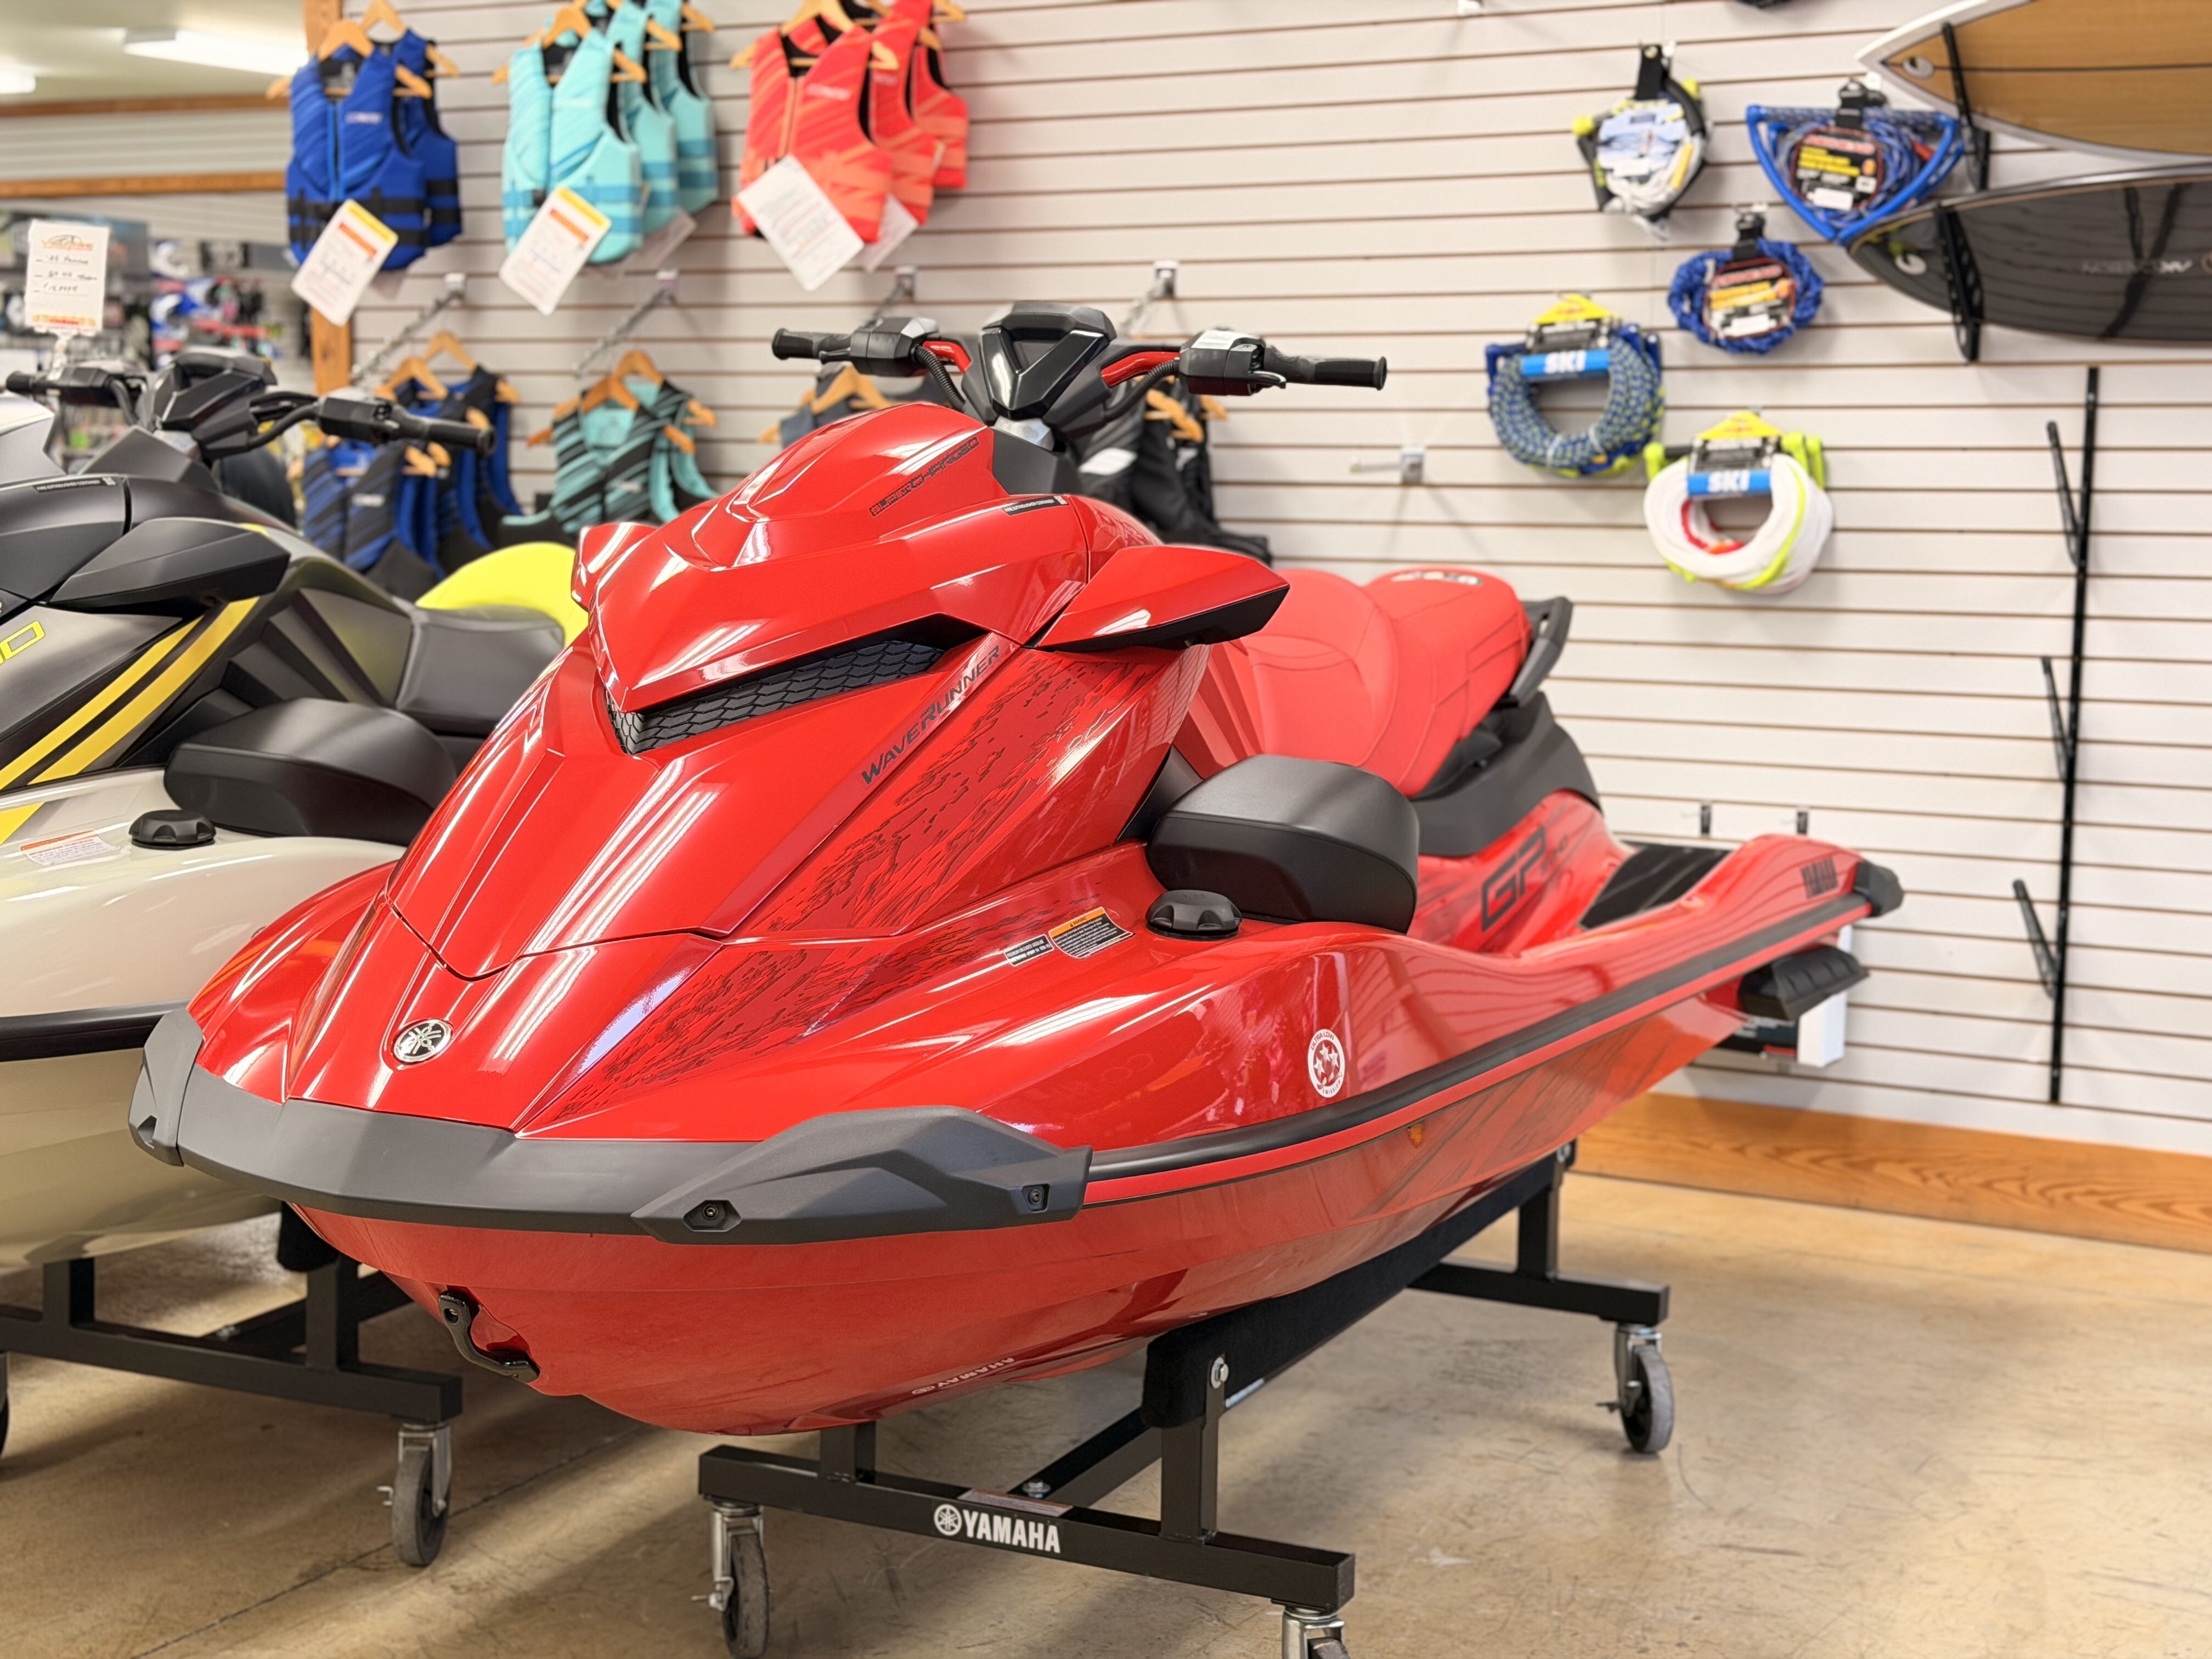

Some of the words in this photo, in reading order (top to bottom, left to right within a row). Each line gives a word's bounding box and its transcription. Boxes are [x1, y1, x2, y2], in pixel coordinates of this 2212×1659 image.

[1544, 349, 1587, 374] SKI
[1707, 470, 1751, 493] SKI
[861, 645, 1000, 785] WAVERUNNER
[1482, 825, 1547, 933] GP
[1310, 1031, 1335, 1051] ULTRA-LOW
[962, 1509, 1061, 1554] YAMAHA
